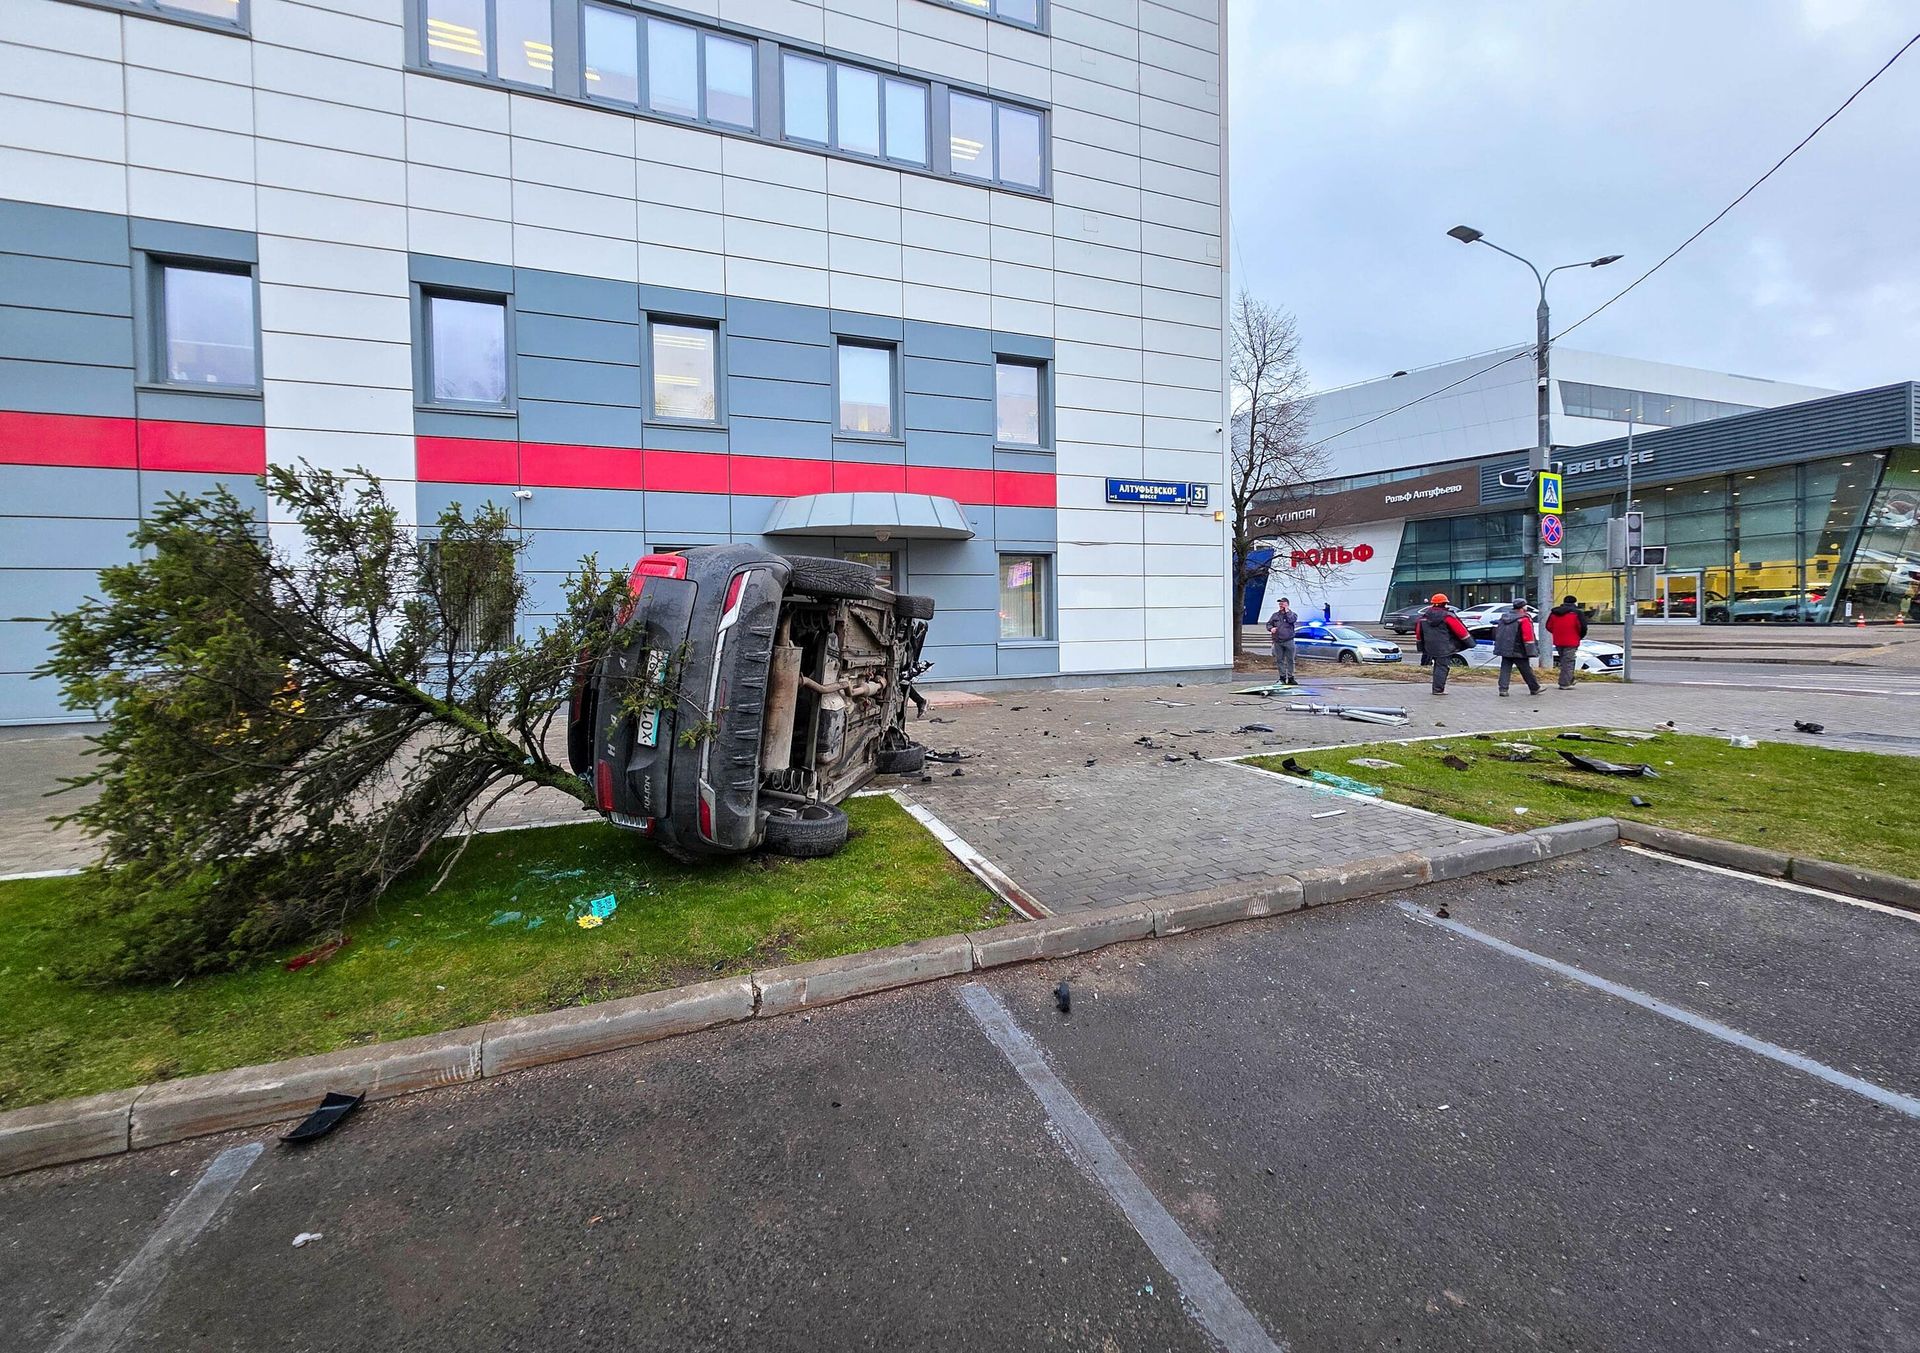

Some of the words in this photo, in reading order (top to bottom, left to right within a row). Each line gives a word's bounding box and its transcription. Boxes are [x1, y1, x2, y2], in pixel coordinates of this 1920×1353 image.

[1566, 450, 1655, 475] BELGEE
[1119, 484, 1177, 496] АЛТУФЬЕВСКОЕ
[1194, 487, 1206, 500] 31
[1385, 492, 1412, 504] Рольф
[1413, 484, 1462, 499] Алтуфьево
[1291, 544, 1374, 568] РОЛЬФ
